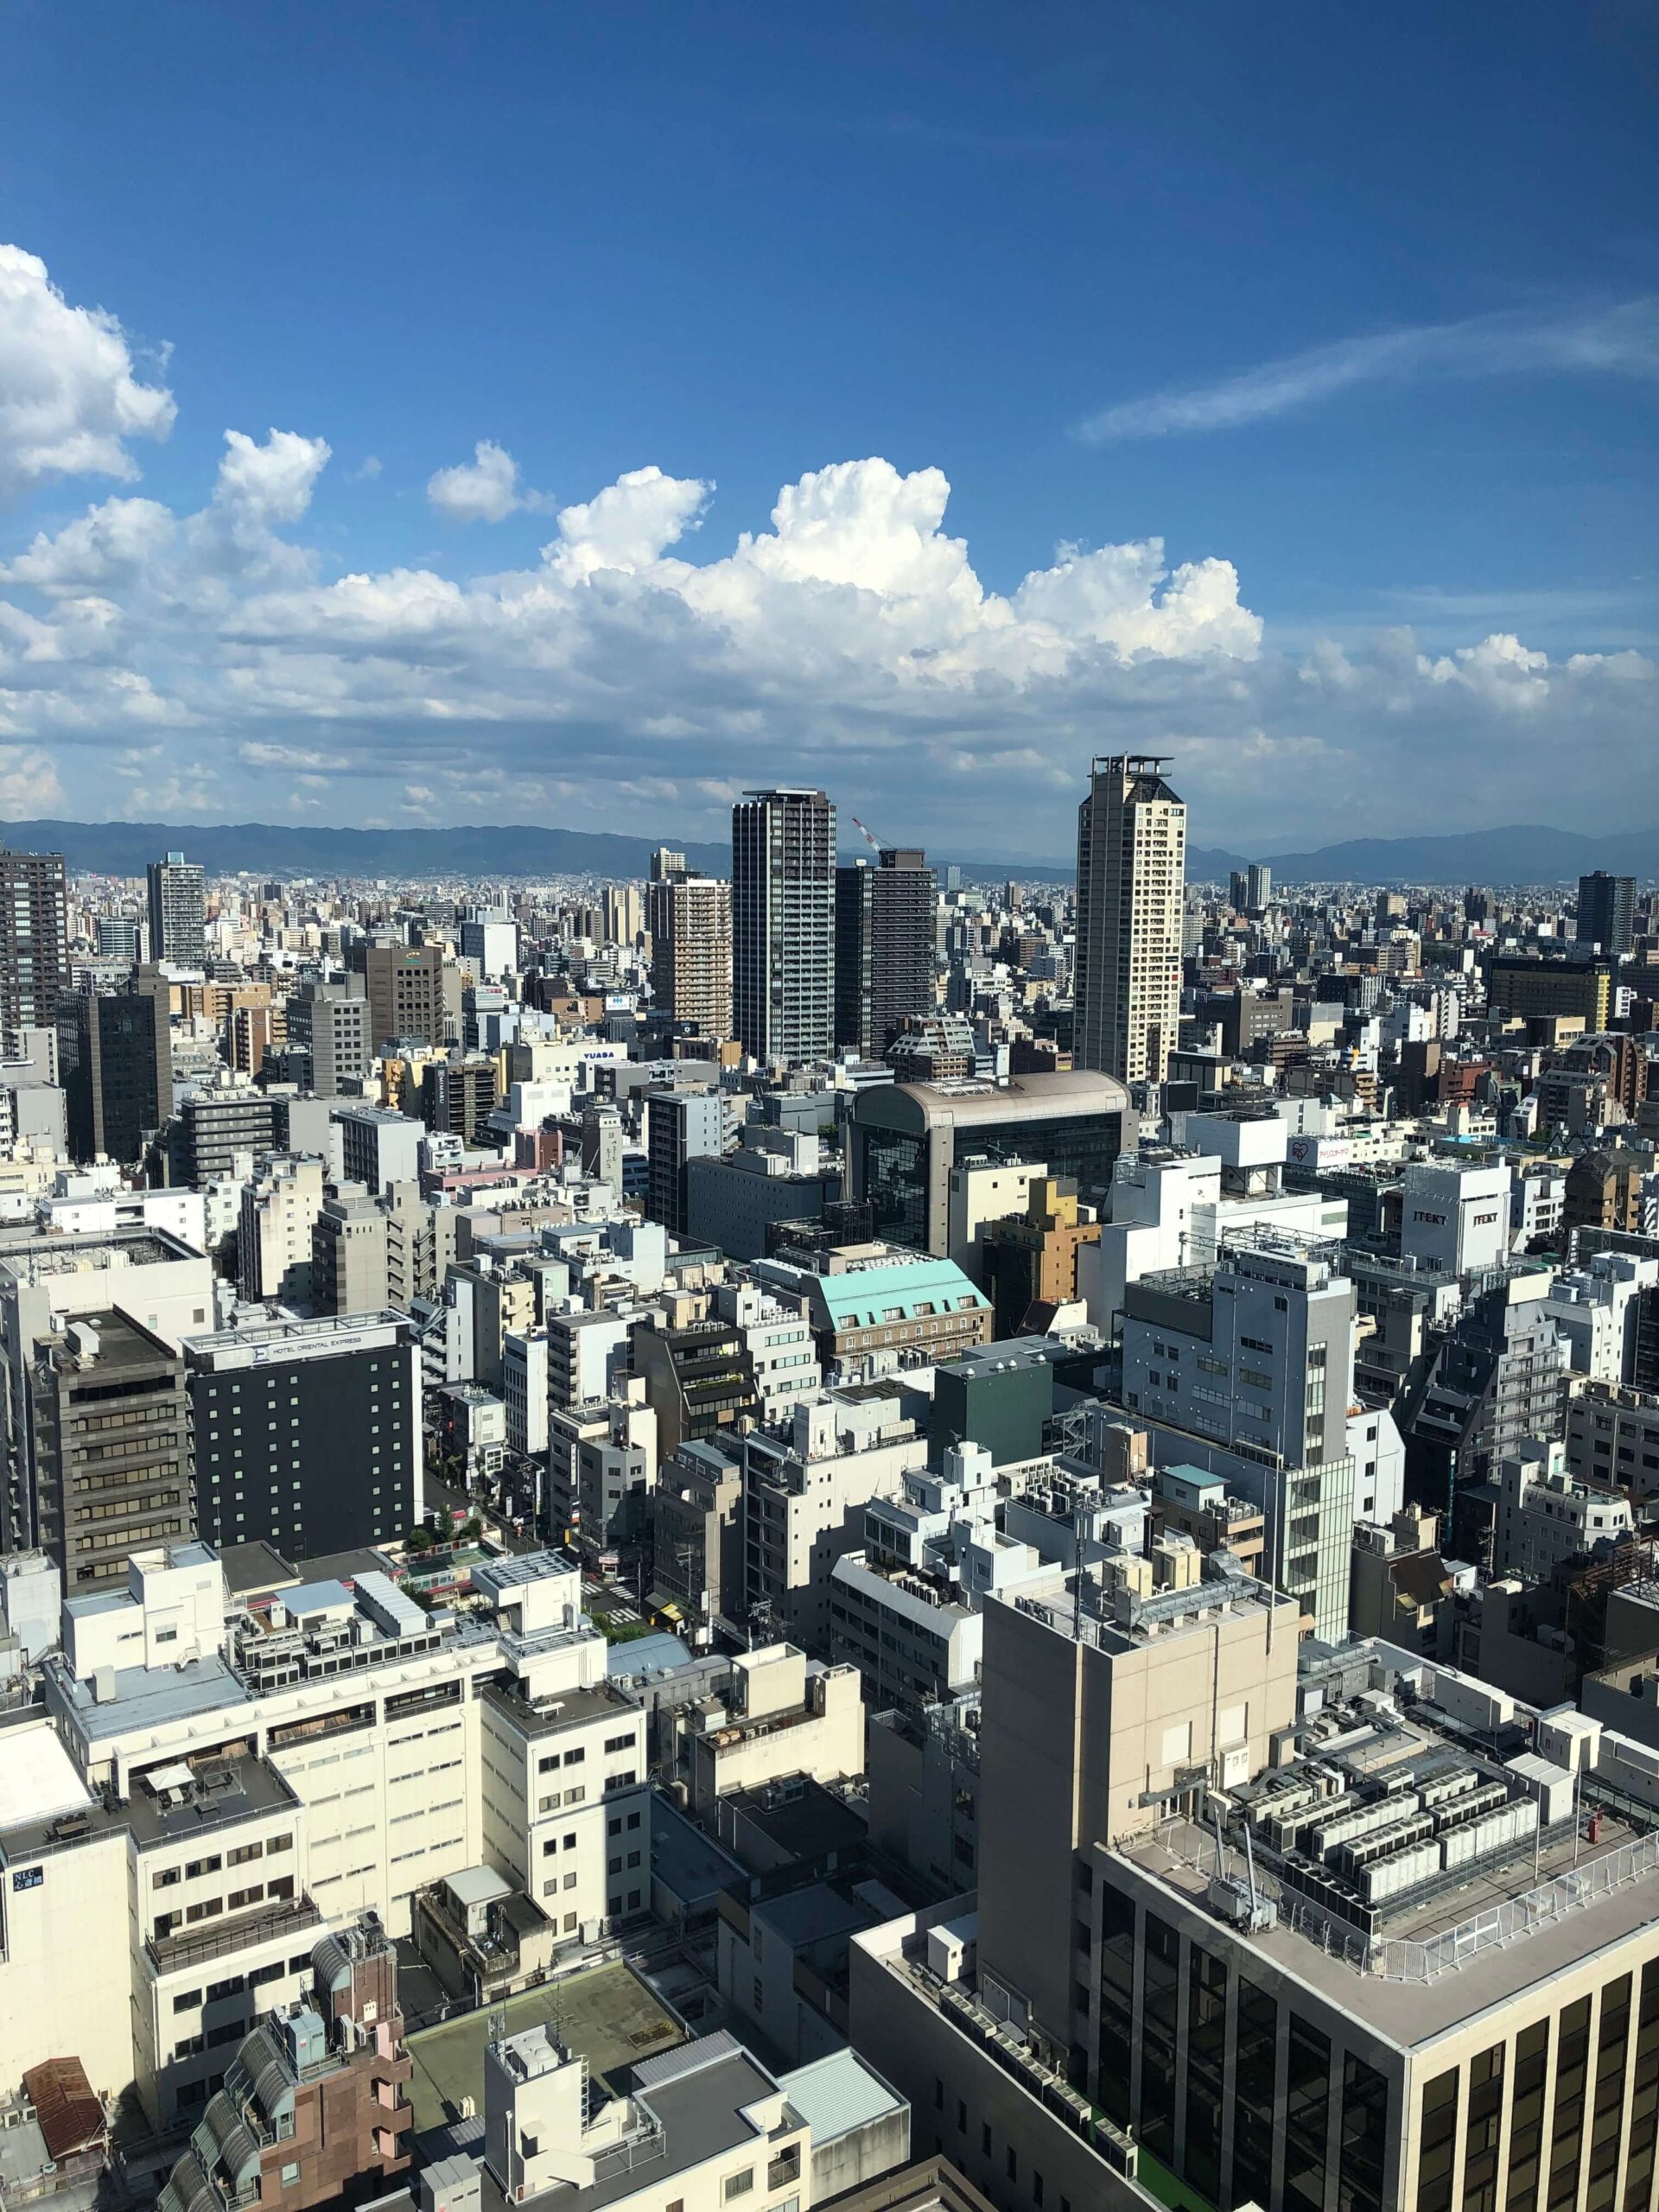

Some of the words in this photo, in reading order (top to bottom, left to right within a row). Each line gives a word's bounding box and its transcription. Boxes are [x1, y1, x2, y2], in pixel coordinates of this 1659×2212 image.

[1413, 1211, 1447, 1226] JTEKT
[1472, 1212, 1498, 1228] JTEKT
[297, 1342, 328, 1351] ORIENTAL
[331, 1337, 362, 1347] EXPRESS
[15, 1870, 35, 1882] NLC
